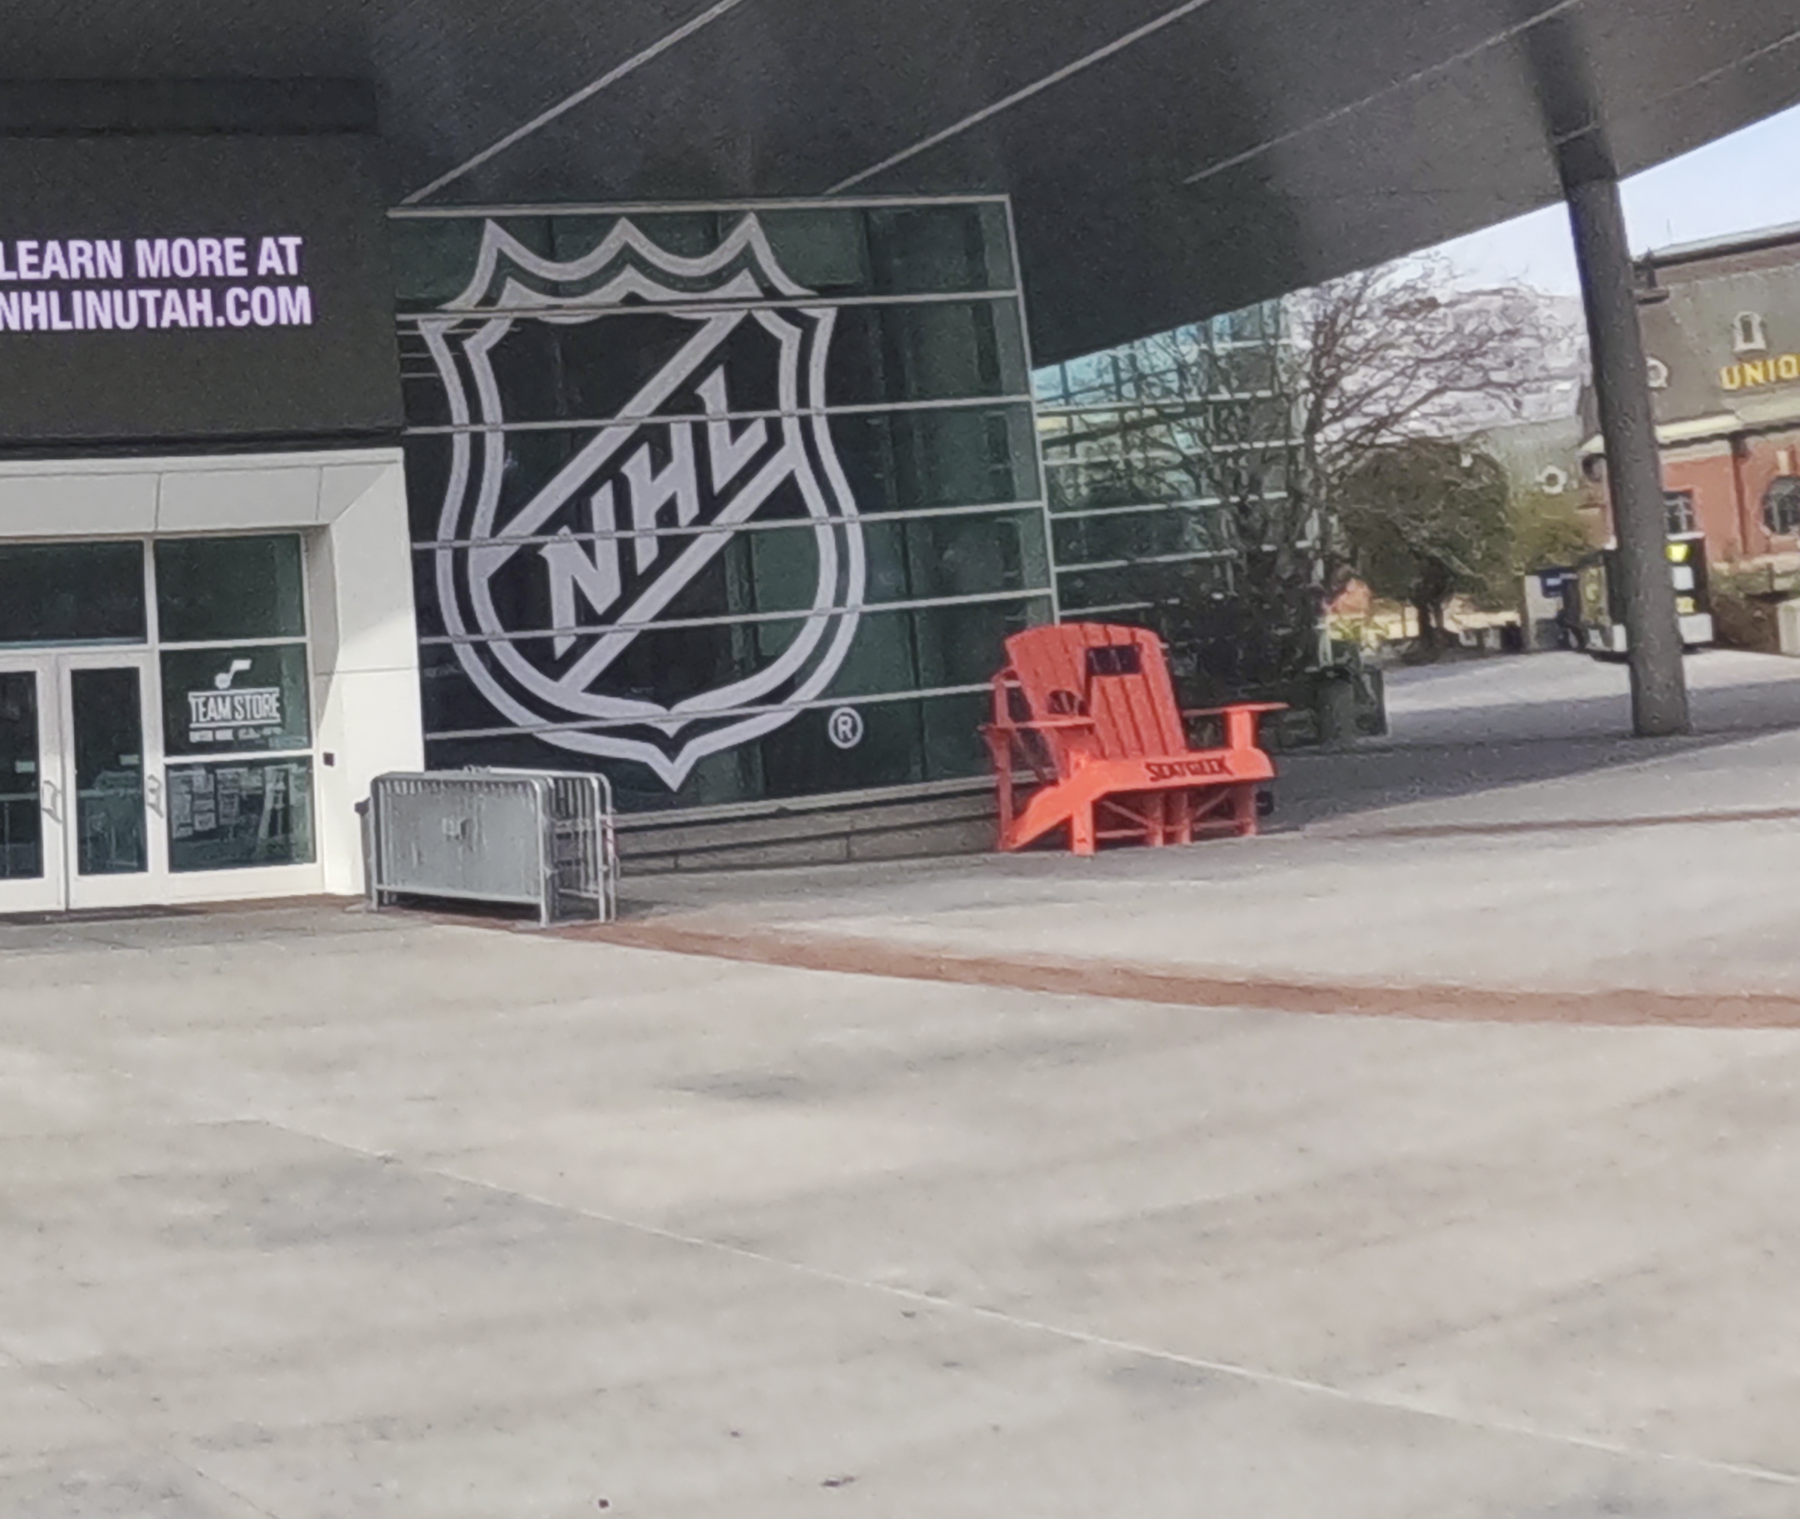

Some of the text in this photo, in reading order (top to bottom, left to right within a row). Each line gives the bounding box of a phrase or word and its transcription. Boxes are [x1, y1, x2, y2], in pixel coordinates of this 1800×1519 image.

[135, 237, 248, 278] MORE
[257, 236, 303, 276] AT
[538, 364, 768, 661] NHL
[189, 692, 281, 723] TEAM STORE
